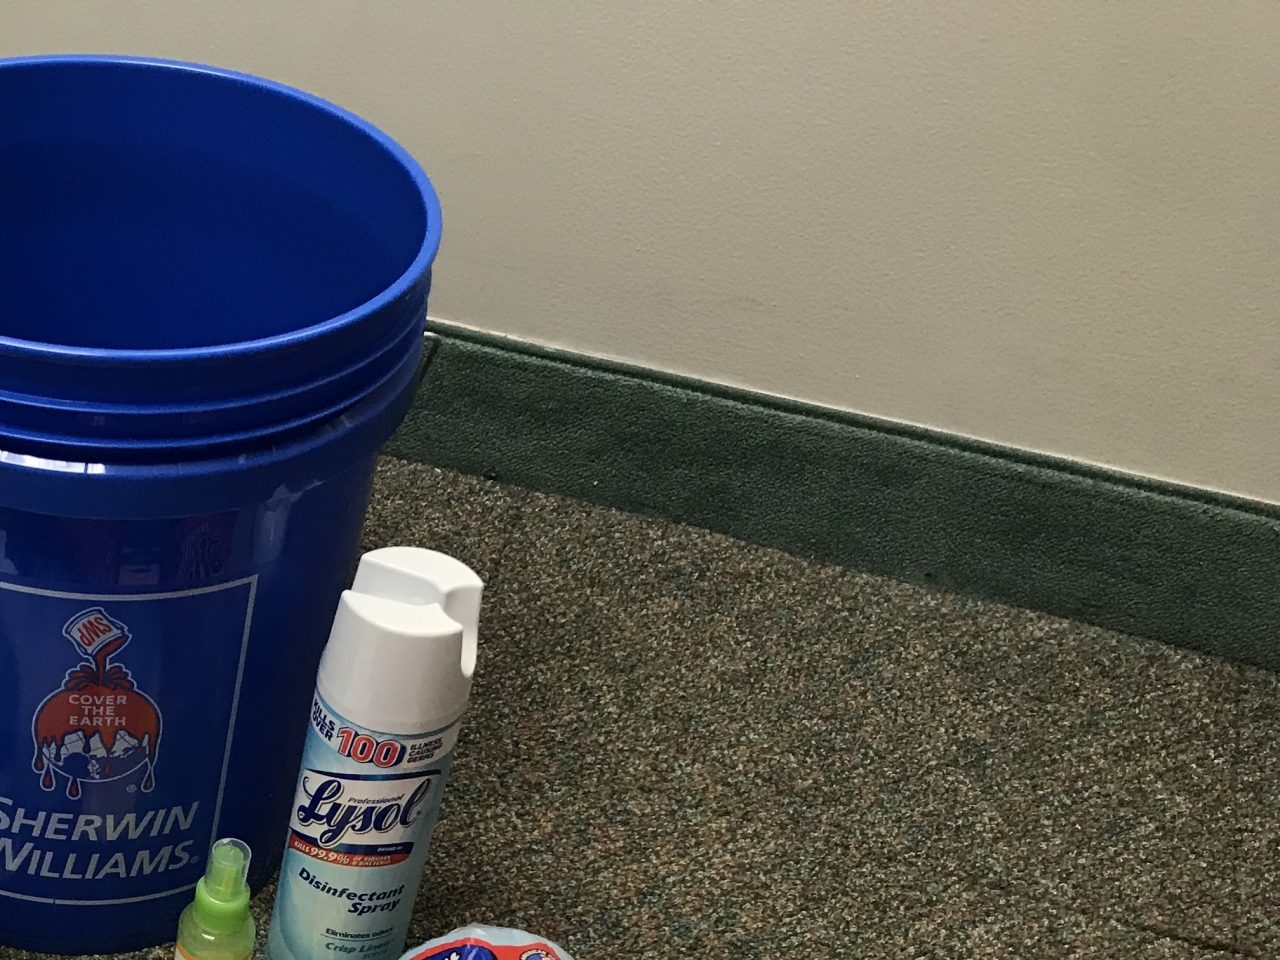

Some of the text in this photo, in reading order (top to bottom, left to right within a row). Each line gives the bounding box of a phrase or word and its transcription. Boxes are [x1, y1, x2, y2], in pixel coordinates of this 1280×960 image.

[77, 617, 113, 647] SWP
[68, 694, 128, 705] COVER
[69, 716, 127, 726] EARTH
[81, 706, 115, 716] THE
[314, 699, 336, 732] KILLS
[313, 710, 333, 741] OVER
[336, 726, 407, 768] 100
[347, 794, 405, 805] Professional
[297, 776, 431, 846] Lysol
[294, 841, 350, 865] KILLS 99.9%
[298, 867, 406, 902] Disinfectant
[347, 899, 401, 917] Spray
[325, 928, 371, 939] Eliminates
[325, 942, 357, 954] Crisp
